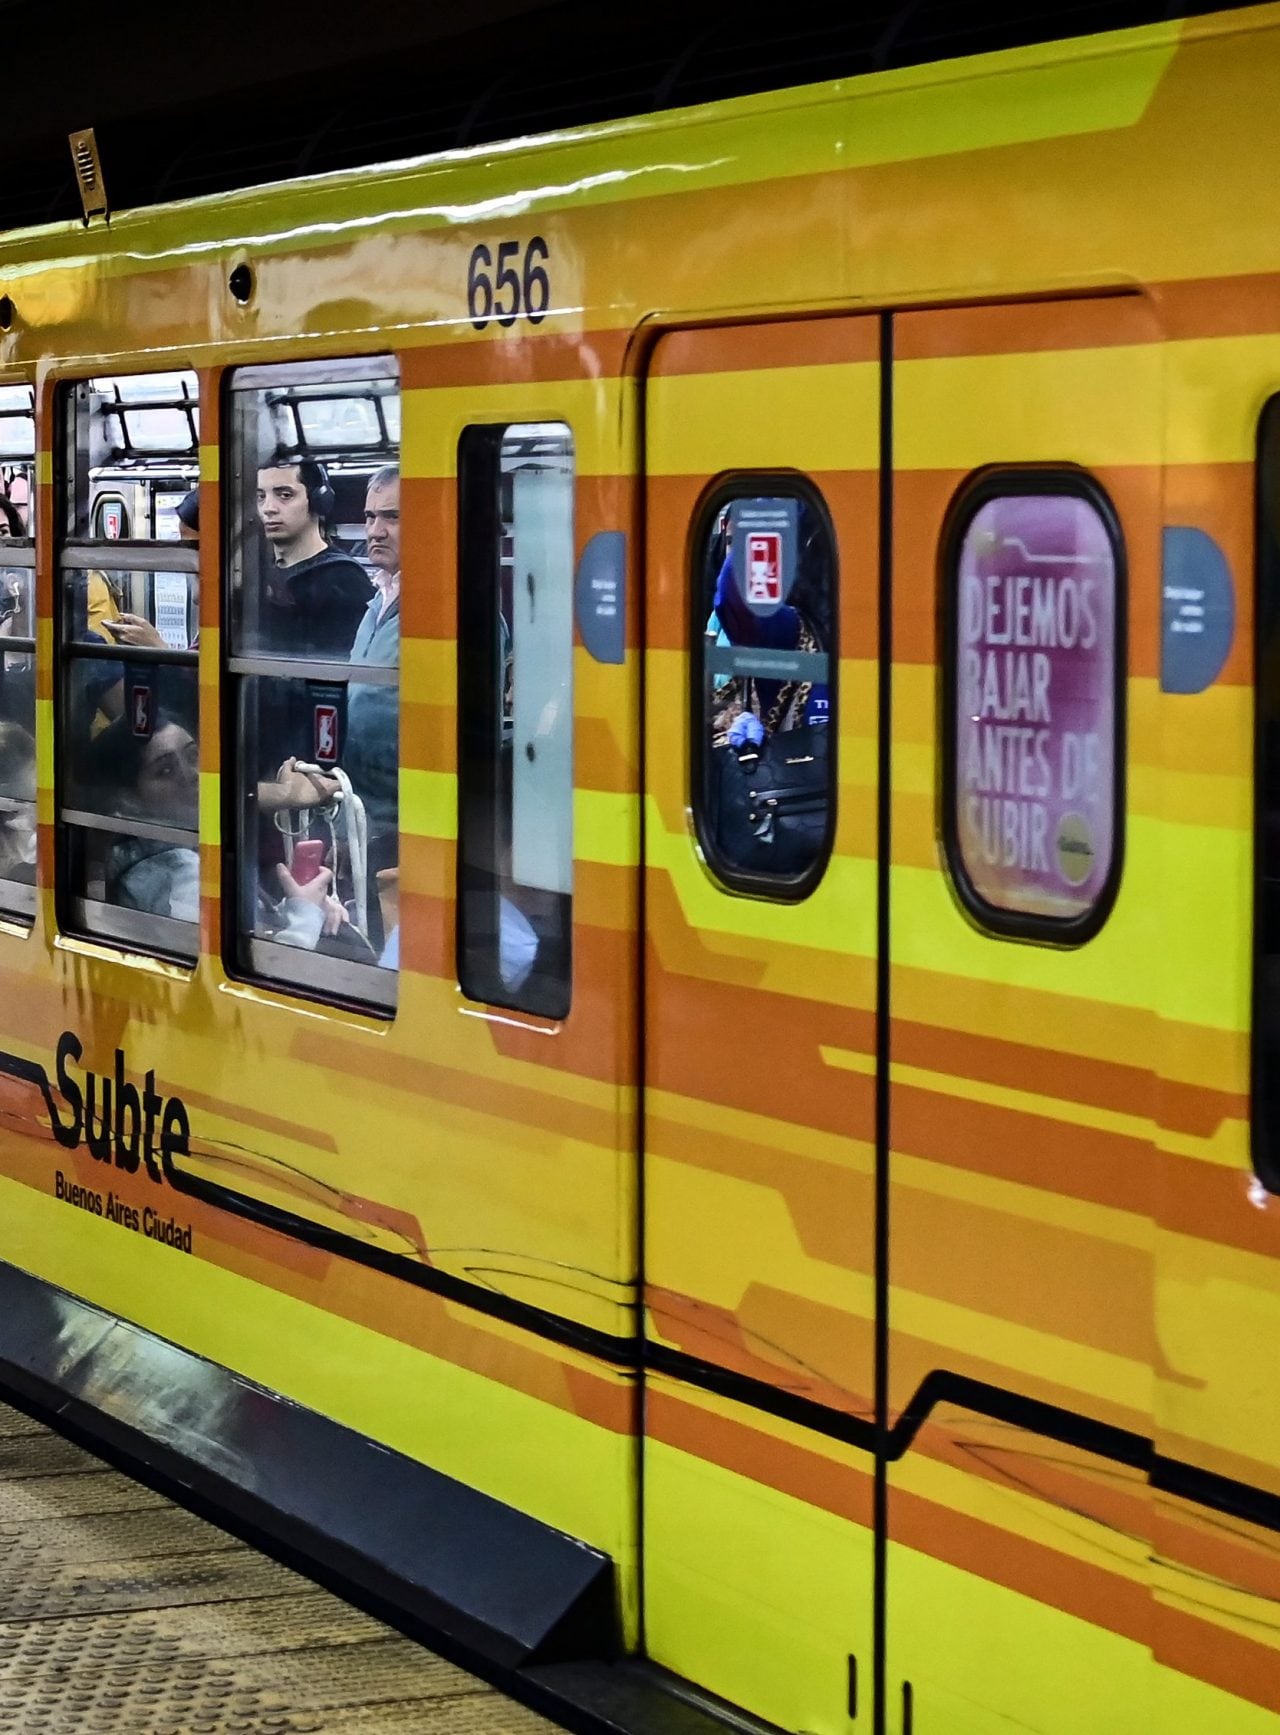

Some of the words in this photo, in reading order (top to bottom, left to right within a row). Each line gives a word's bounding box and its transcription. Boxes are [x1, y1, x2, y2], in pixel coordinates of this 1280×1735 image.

[468, 235, 550, 331] 656
[963, 576, 1097, 649] DEJEMOS
[963, 648, 1053, 723] BAJAR
[965, 727, 1053, 798] ANTES
[1062, 732, 1102, 801] DE
[967, 796, 1051, 873] SUBIR
[53, 1031, 191, 1191] Subte
[55, 1170, 102, 1216] Buenos
[106, 1191, 139, 1232] Aires
[142, 1206, 192, 1254] Ciudad
